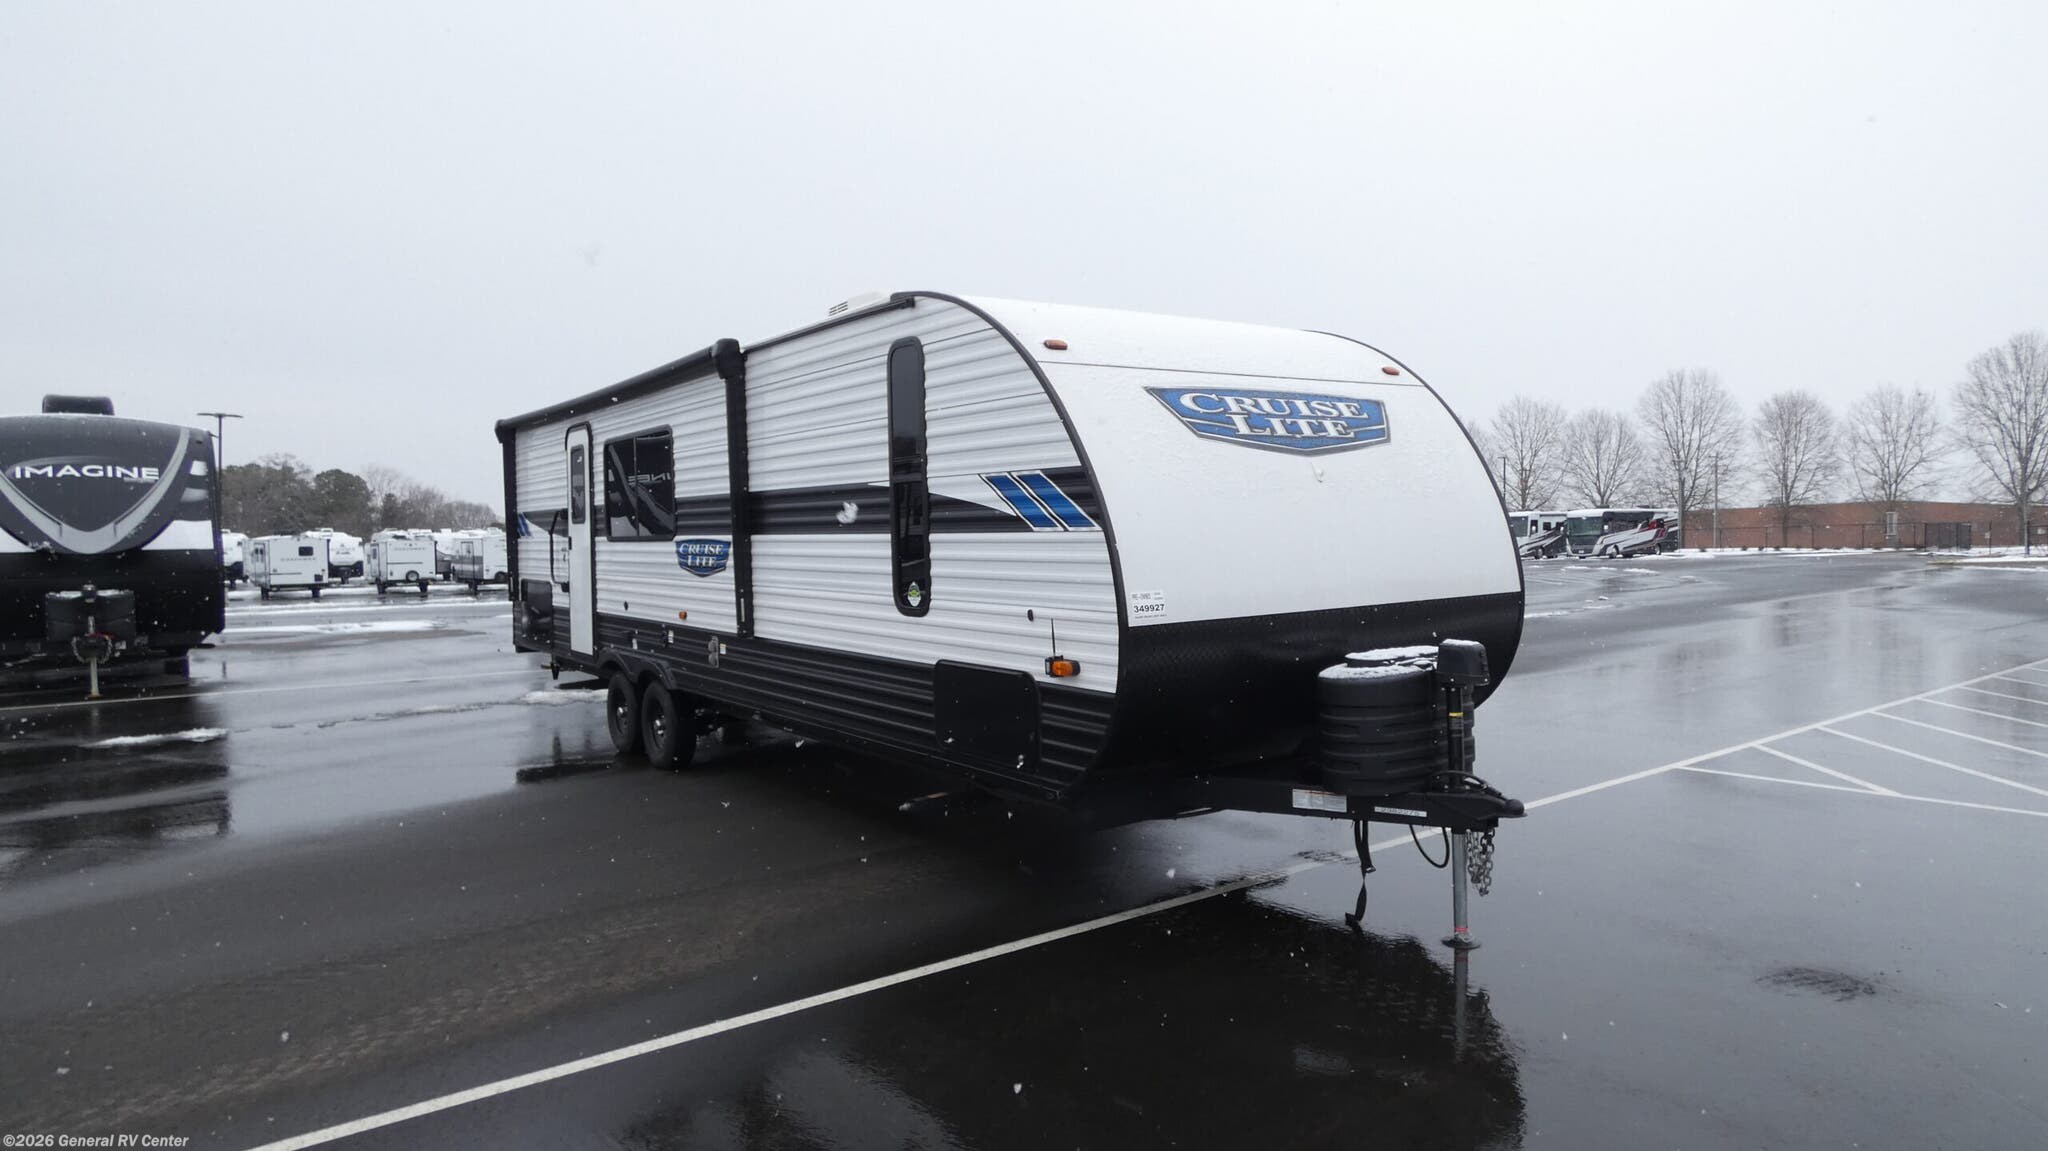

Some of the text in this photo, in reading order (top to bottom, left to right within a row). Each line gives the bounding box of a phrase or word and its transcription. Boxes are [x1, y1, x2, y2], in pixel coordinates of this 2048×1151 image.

[1179, 392, 1369, 419] CRUISE
[1226, 414, 1355, 438] LITE
[15, 464, 160, 480] IMAGINE
[679, 543, 724, 555] CRUISE
[687, 555, 717, 567] LITE
[1133, 603, 1165, 613] 349927
